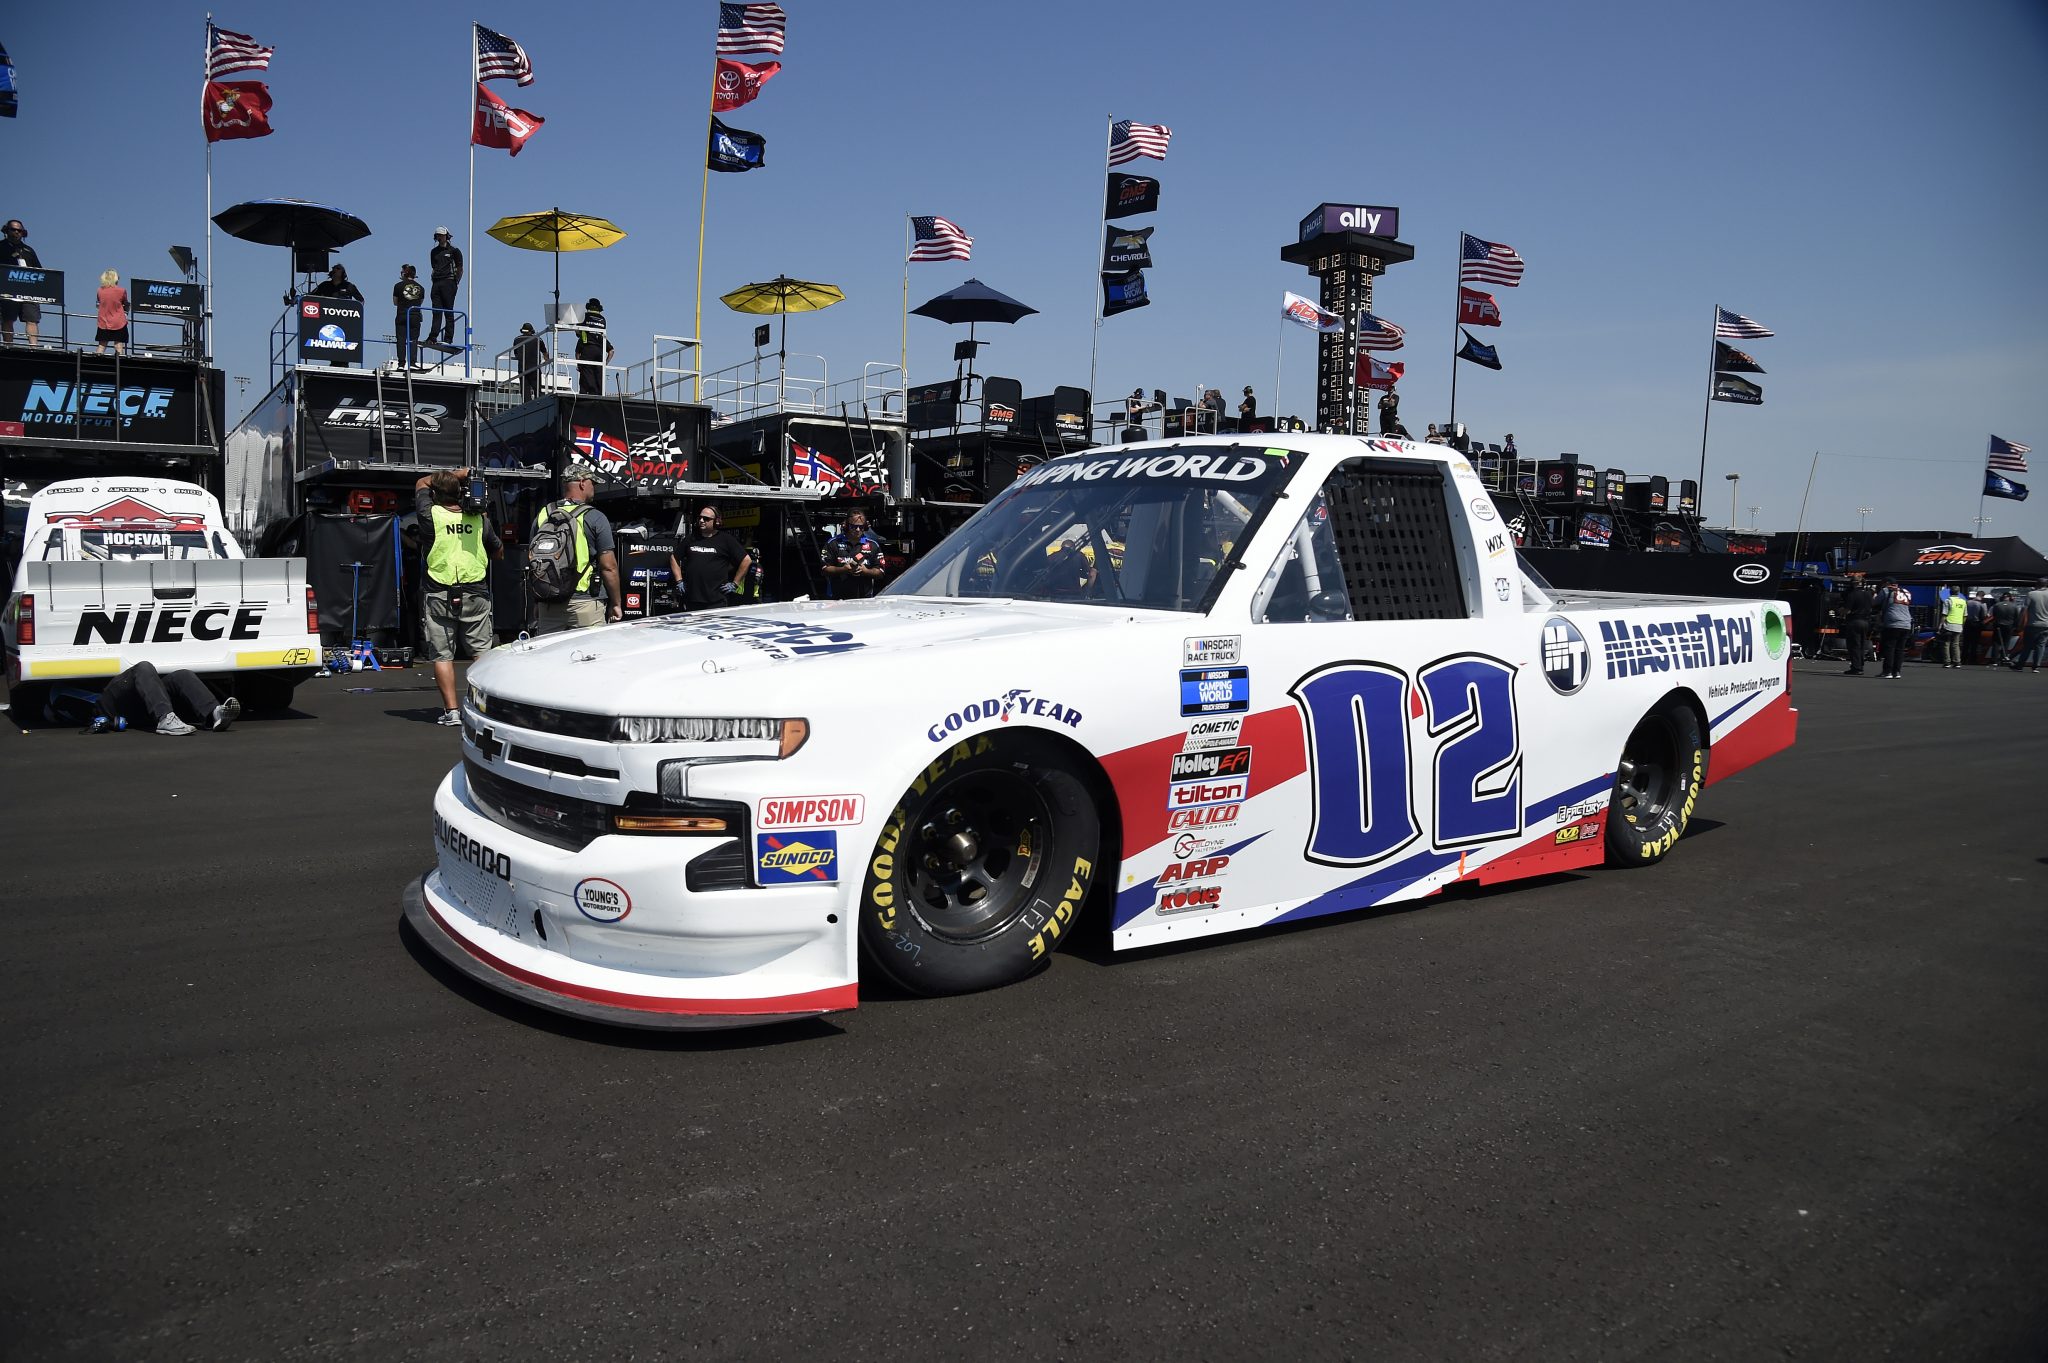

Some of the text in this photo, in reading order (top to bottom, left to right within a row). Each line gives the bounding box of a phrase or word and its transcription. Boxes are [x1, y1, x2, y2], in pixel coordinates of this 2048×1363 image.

[716, 92, 739, 100] TOYOTA
[1120, 183, 1148, 200] GMS
[1118, 195, 1145, 206] RACING
[1340, 207, 1381, 234] ally
[9, 270, 45, 282] NIECE
[149, 284, 183, 296] NIECE
[16, 294, 56, 303] CHEVROLET
[323, 307, 360, 318] TOYOTA
[1350, 303, 1356, 311] 3
[1350, 317, 1356, 326] 4
[1350, 332, 1355, 340] 5
[311, 339, 347, 350] HALMAR
[1349, 346, 1355, 355] 6
[1349, 361, 1355, 370] 7
[23, 379, 176, 418] NIECE
[989, 409, 1014, 419] GMS
[1055, 422, 1085, 431] CHEVROLET
[1112, 454, 1267, 482] WORLD
[446, 523, 473, 535] NBC
[103, 532, 172, 546] HOCEVAR
[1485, 534, 1506, 553] WIX
[630, 544, 674, 552] MENARDS
[1918, 552, 1986, 562] GMS
[1741, 568, 1764, 576] YOUNG'S
[73, 601, 269, 646] NIECE
[1202, 639, 1233, 651] NASCAR
[282, 647, 311, 665] 42
[1188, 651, 1235, 662] RACE TRUCK
[1207, 671, 1230, 679] NASCAR
[1198, 680, 1233, 692] CAMPING
[1708, 677, 1780, 698] Vehicle Protection Program
[1199, 690, 1233, 703] WORLD
[1191, 720, 1240, 735] COMETIC
[1173, 750, 1249, 776] Holley EFI
[1286, 651, 1523, 869] 02
[1174, 784, 1242, 804] tilton
[764, 798, 857, 825] SIMPSON
[1170, 804, 1240, 829] CALICO
[434, 810, 511, 882] SILVERADO
[763, 850, 832, 867] SUNOCO
[1157, 855, 1230, 883] ARP
[584, 888, 619, 905] YOUNG'S
[1160, 886, 1222, 911] KOOKS
[582, 901, 621, 913] MOTORSPORTS
[1027, 856, 1092, 960] EAGLE
